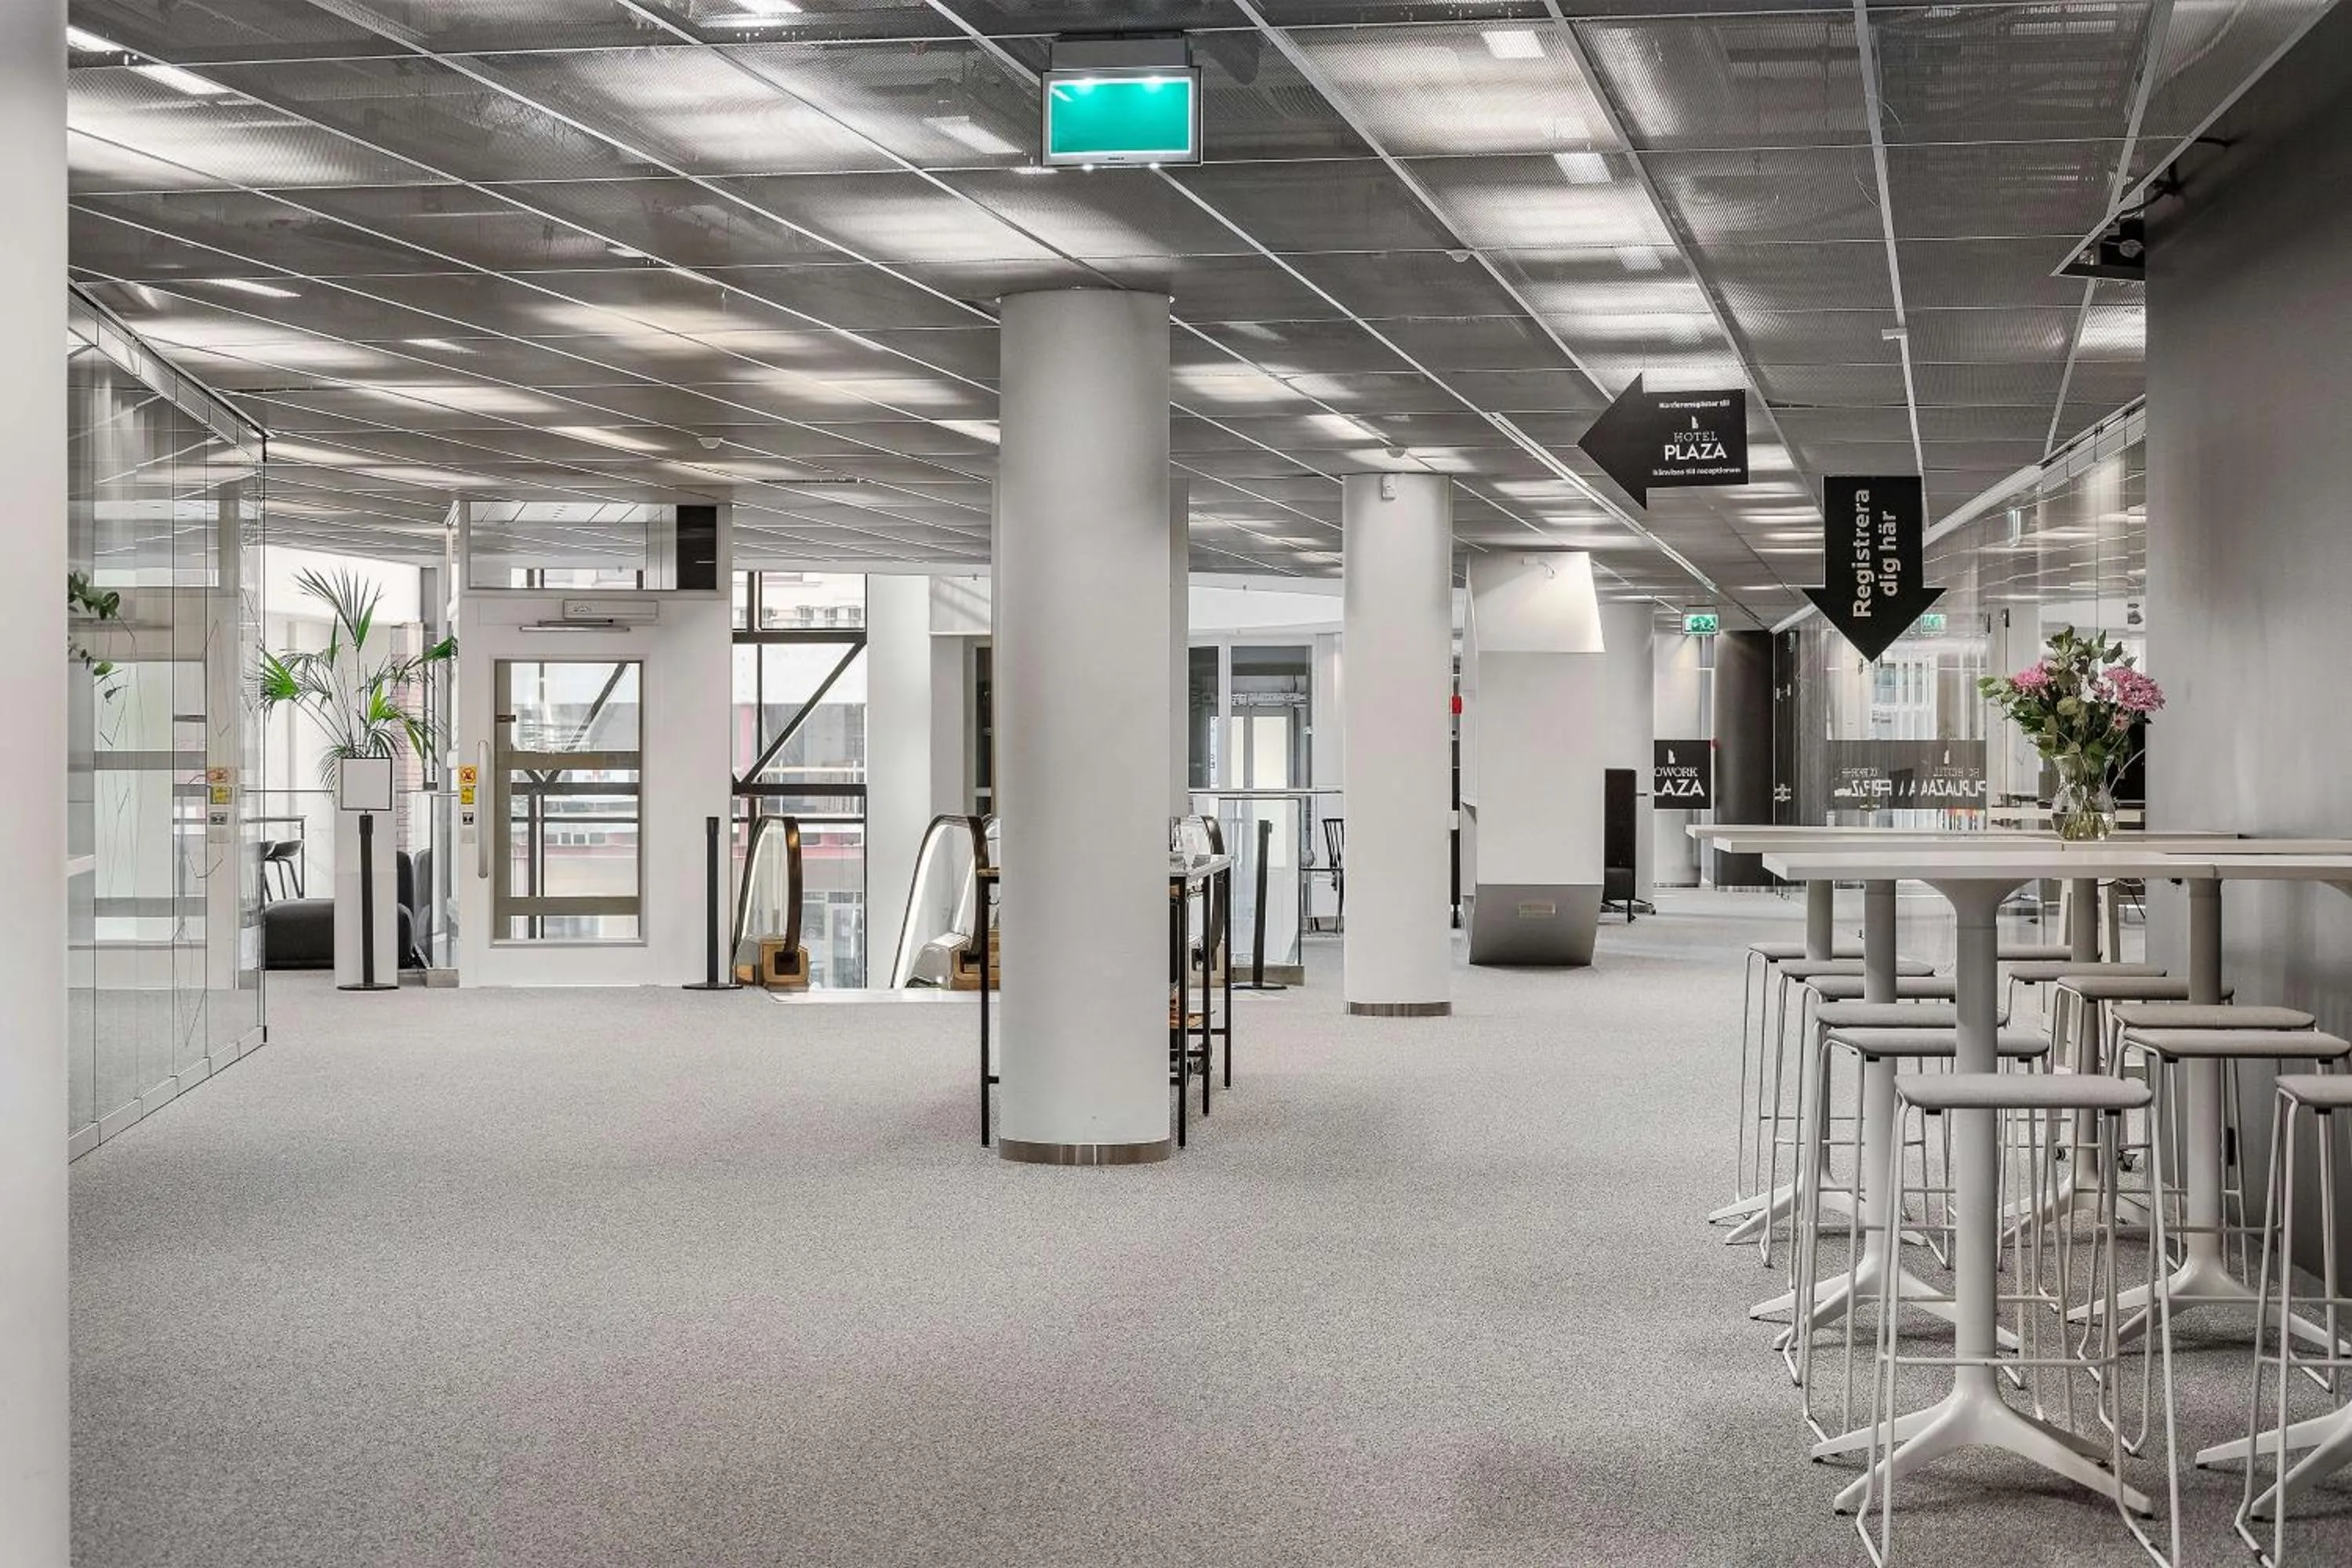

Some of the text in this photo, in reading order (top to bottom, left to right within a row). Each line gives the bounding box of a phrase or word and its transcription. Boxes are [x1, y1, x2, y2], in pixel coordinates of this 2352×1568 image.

[1664, 442, 1727, 461] PLAZA
[1674, 431, 1718, 442] HOTEL
[1851, 489, 1875, 618] Registrera
[1878, 510, 1901, 597] dig här
